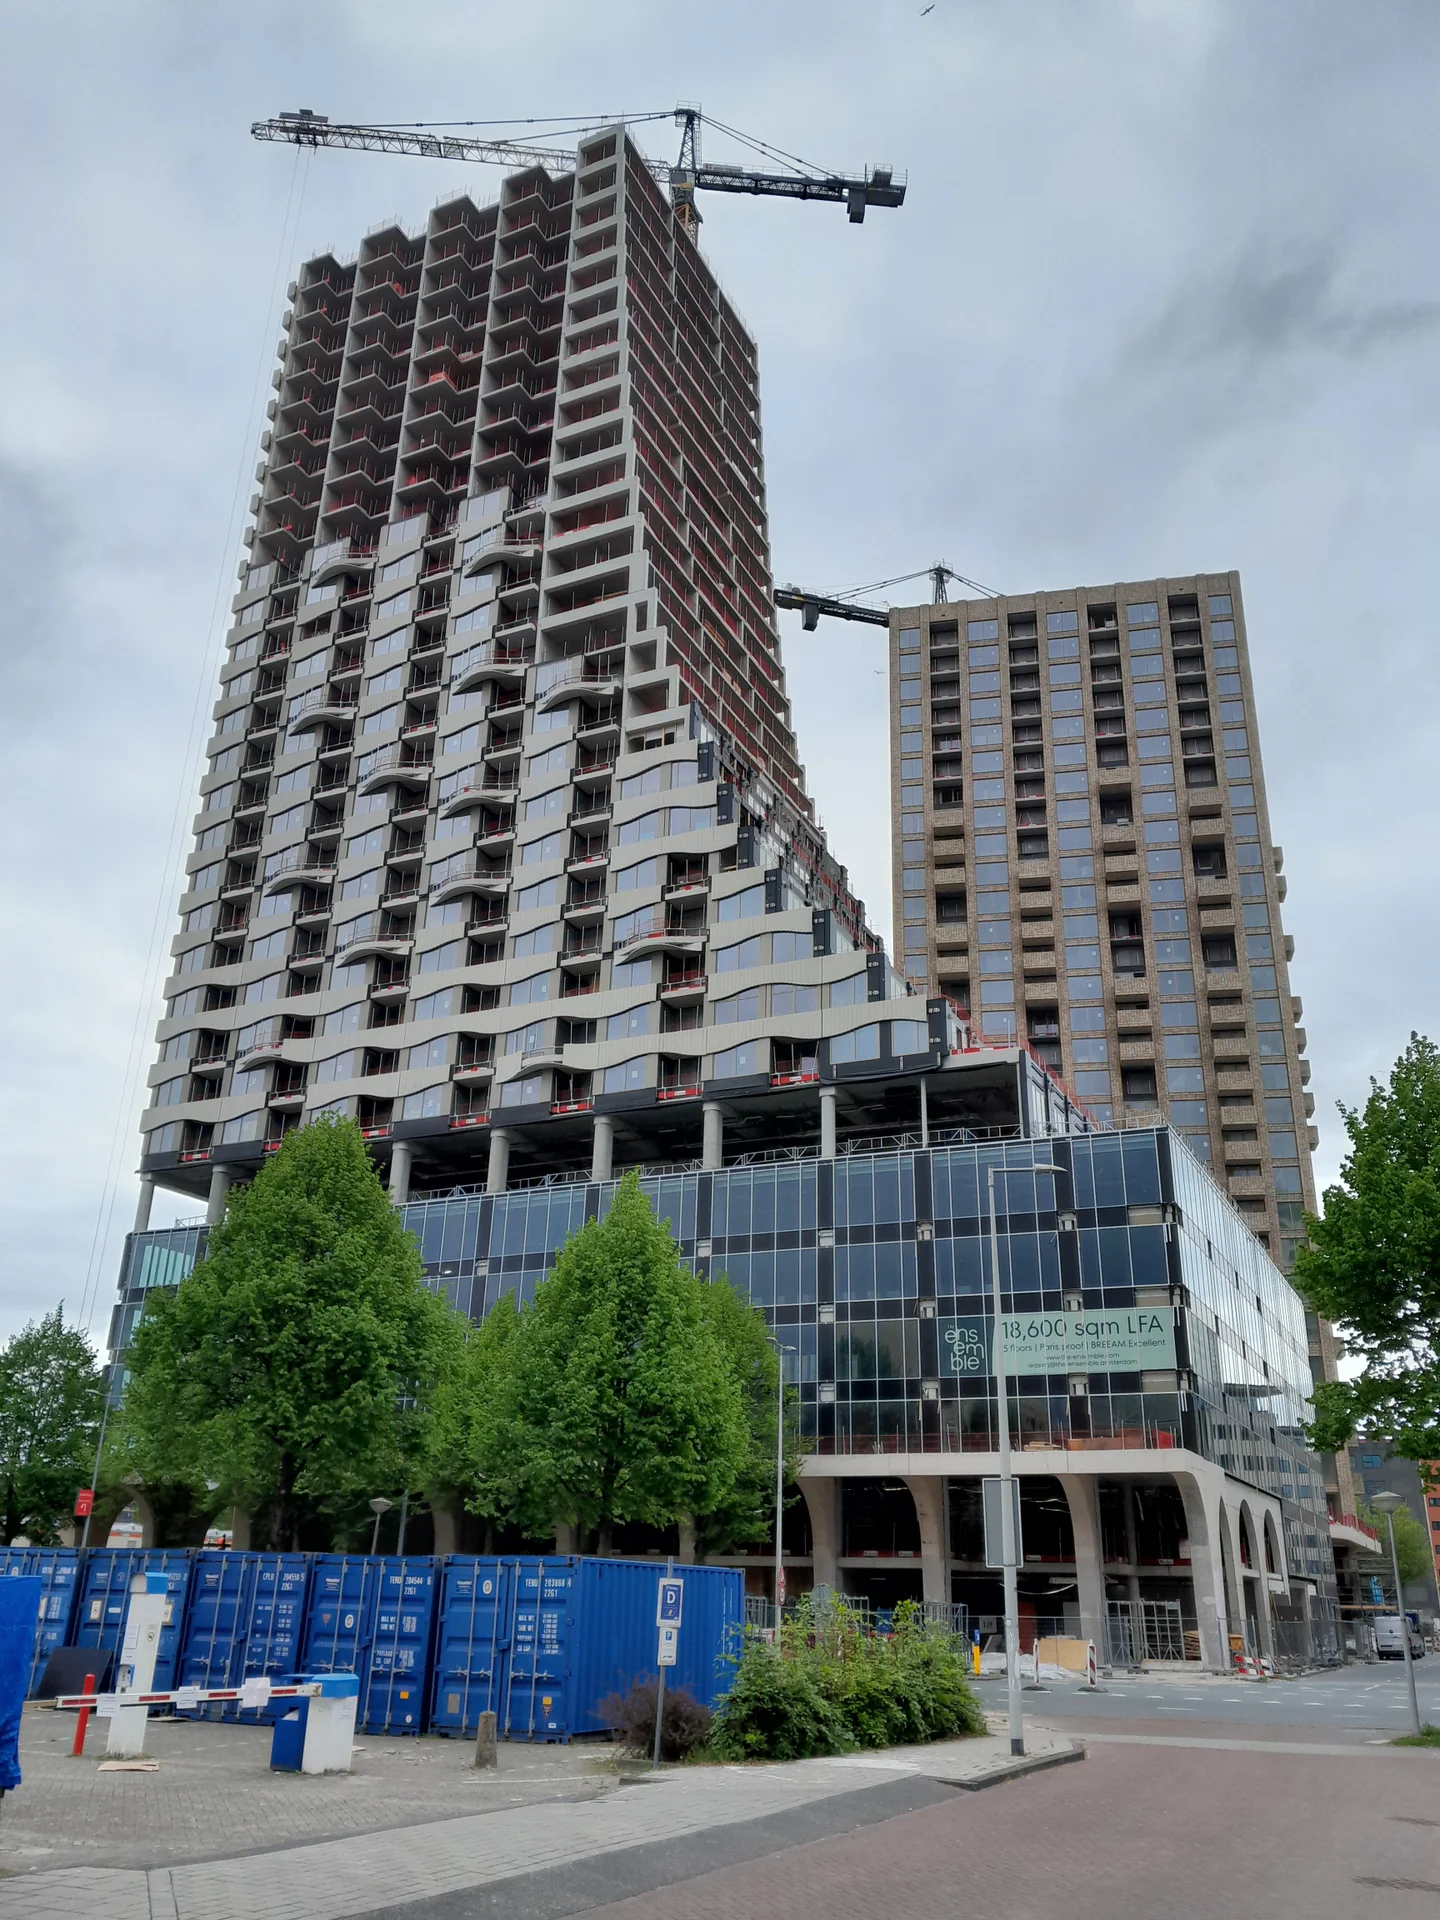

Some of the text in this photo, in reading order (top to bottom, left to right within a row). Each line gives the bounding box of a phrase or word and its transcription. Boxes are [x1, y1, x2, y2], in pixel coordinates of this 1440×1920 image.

[944, 1328, 978, 1343] ens
[1001, 1314, 1164, 1341] 18,600 sqm LFA
[953, 1341, 985, 1359] em
[1010, 1344, 1033, 1352] floors
[1039, 1343, 1060, 1351] Paris
[1061, 1342, 1084, 1352] proof
[1091, 1340, 1126, 1349] BREEAM
[1129, 1339, 1166, 1348] Excellent
[950, 1352, 980, 1371] ble
[666, 1591, 676, 1604] D
